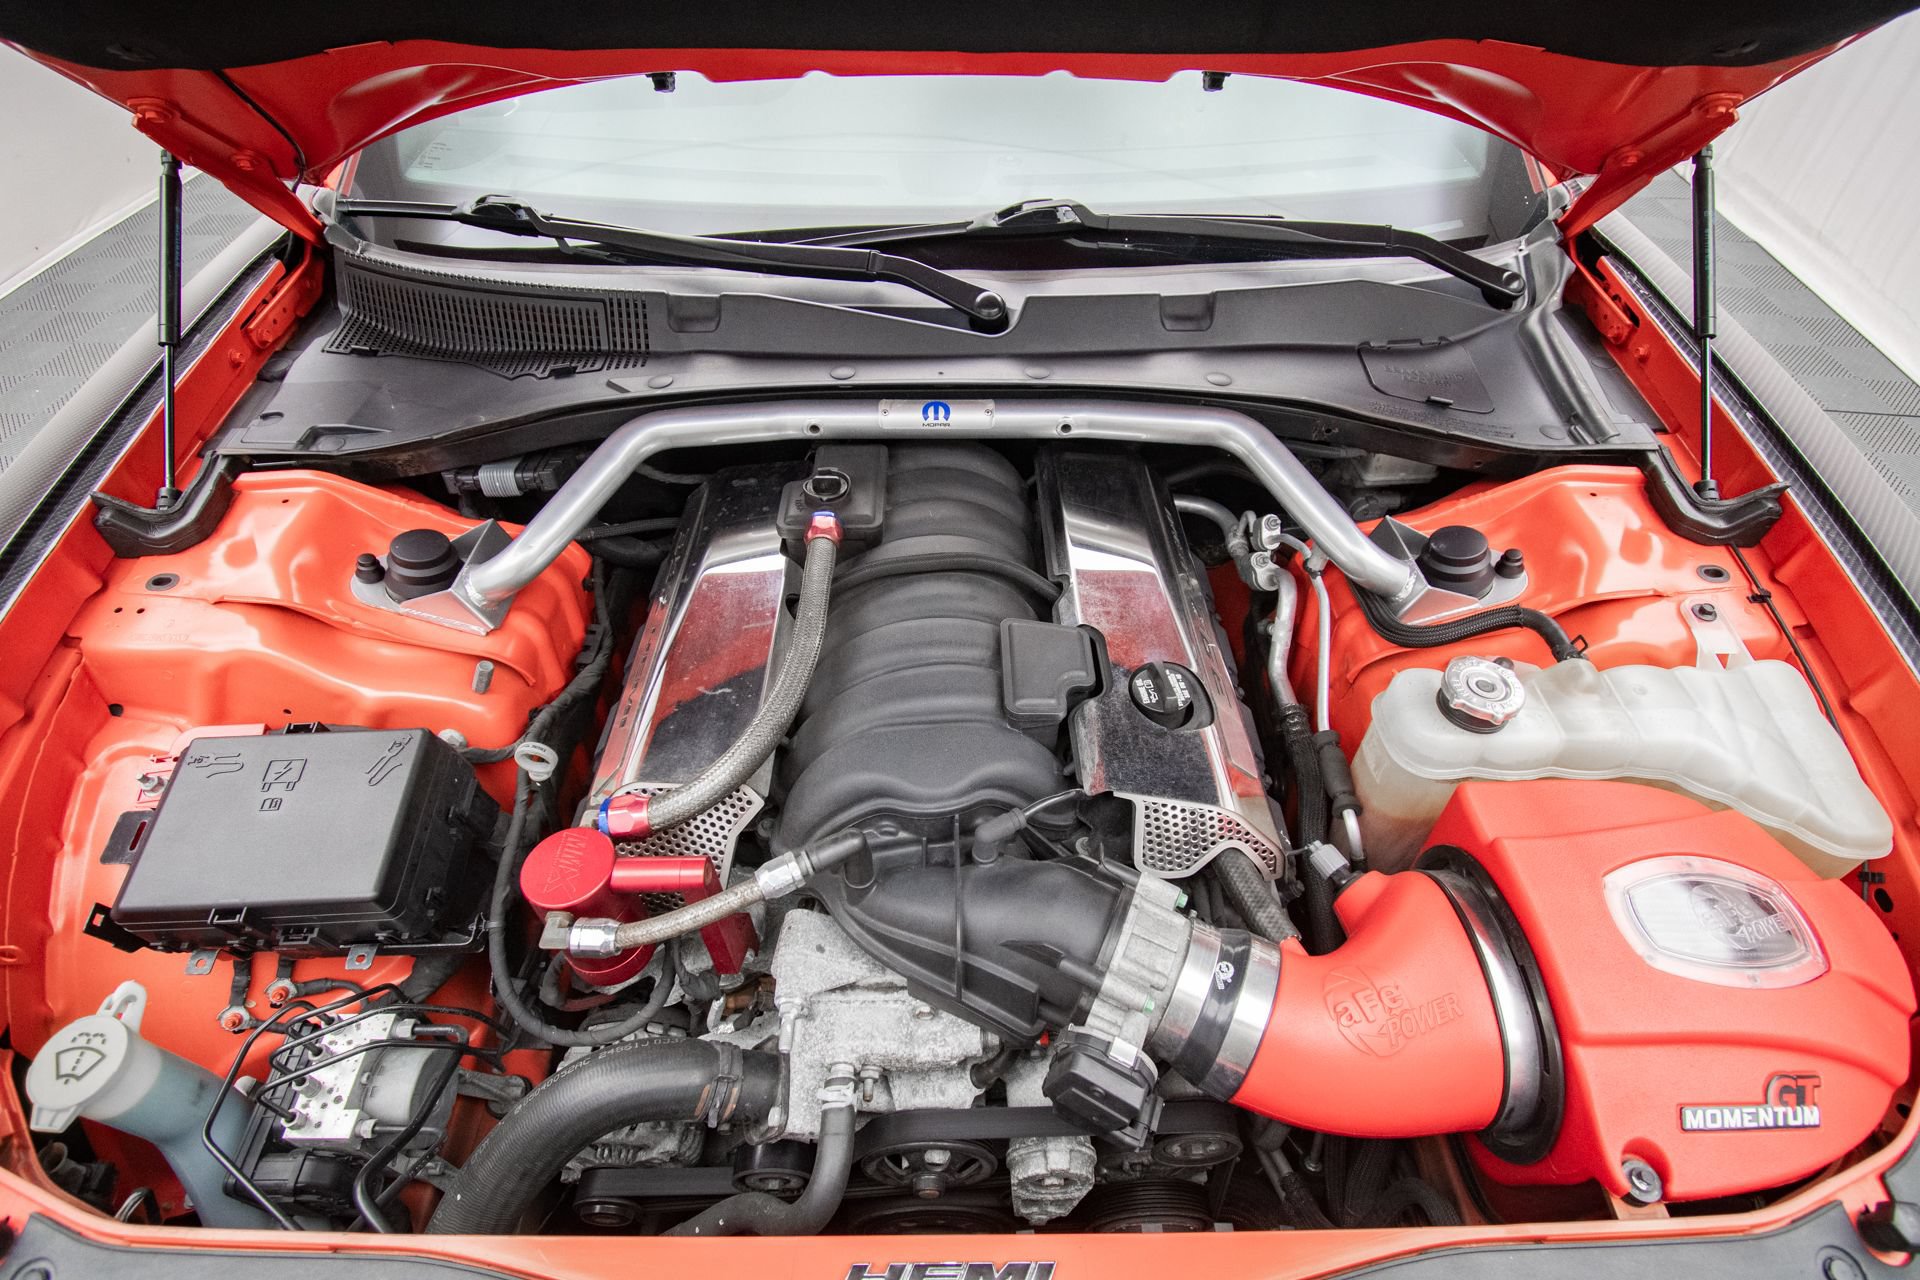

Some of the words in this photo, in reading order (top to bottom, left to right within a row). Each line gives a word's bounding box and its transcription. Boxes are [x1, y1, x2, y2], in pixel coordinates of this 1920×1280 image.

[1333, 984, 1404, 1028] aFe
[1386, 992, 1464, 1050] POWER
[1766, 1074, 1821, 1109] GT
[1684, 1105, 1820, 1129] MOMENTUM
